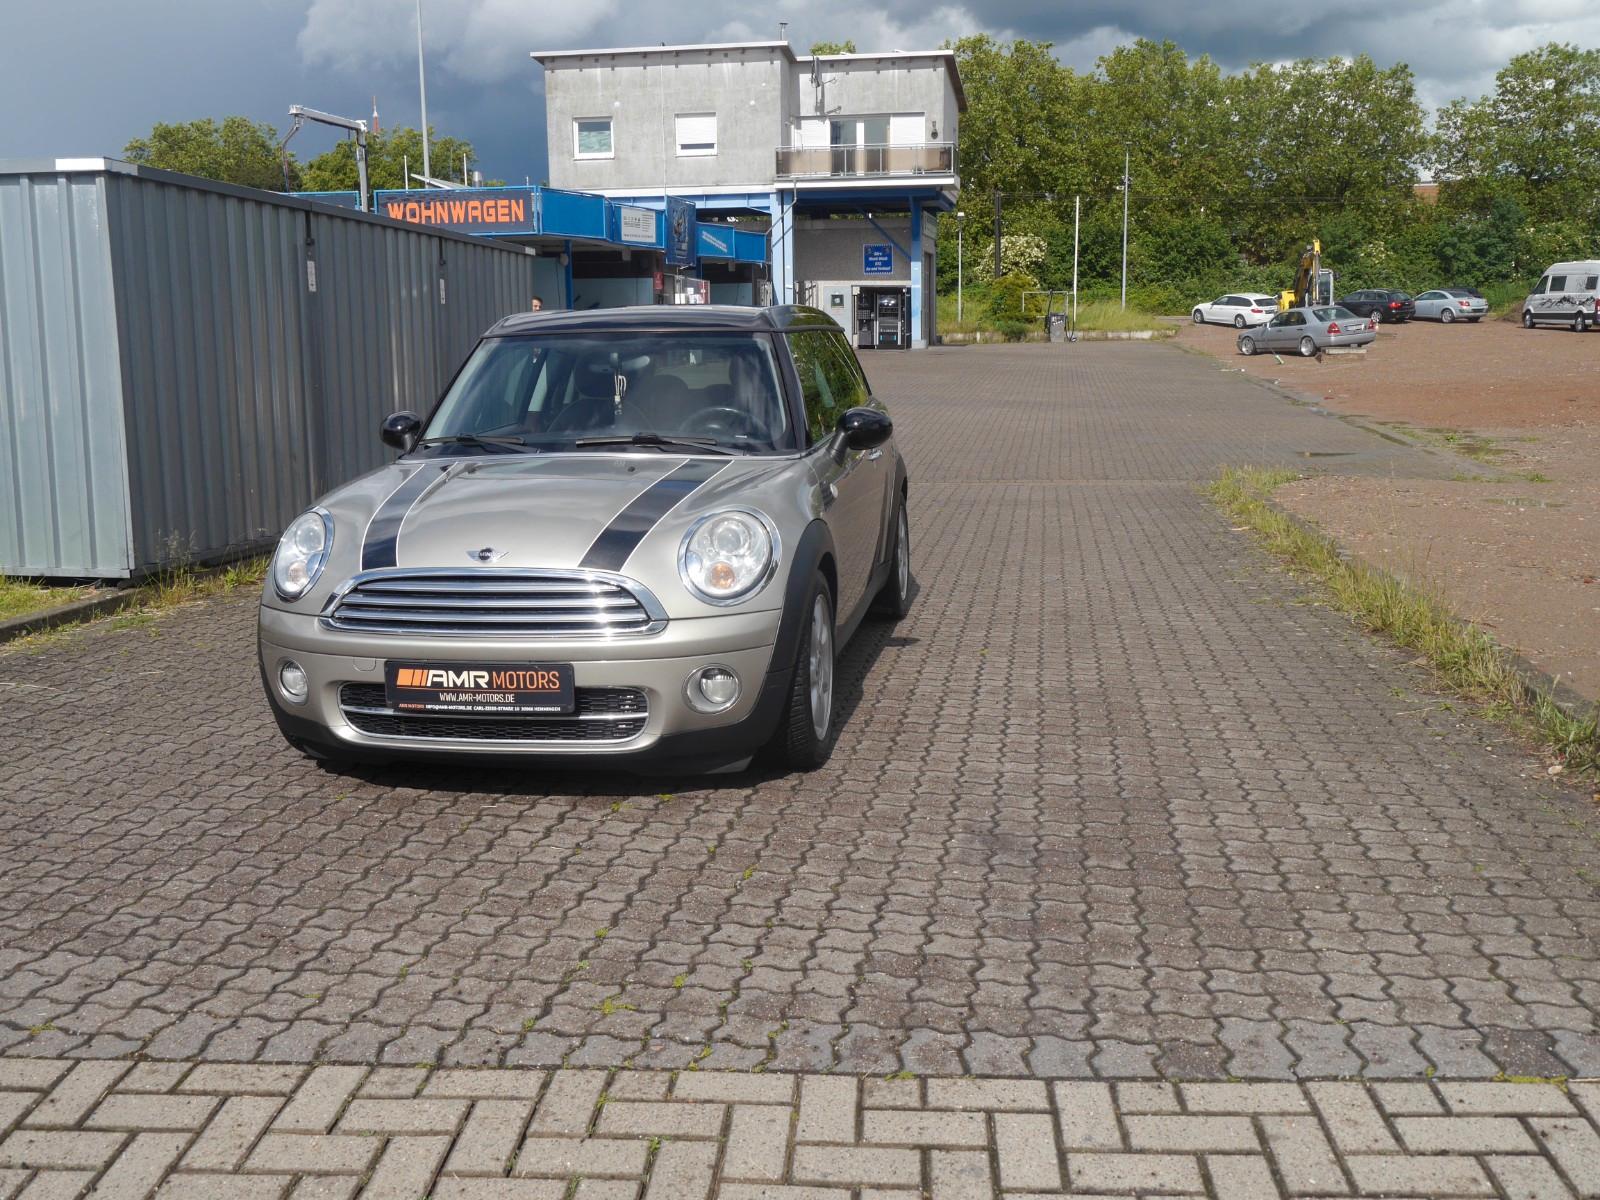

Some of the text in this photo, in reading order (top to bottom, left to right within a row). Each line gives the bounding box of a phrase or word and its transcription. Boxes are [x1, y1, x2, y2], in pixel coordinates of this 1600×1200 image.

[387, 199, 524, 224] WOHNWAGEN
[426, 669, 560, 689] AMR MOTORS
[439, 692, 515, 703] WWW.AMR-MOTORS.DE
